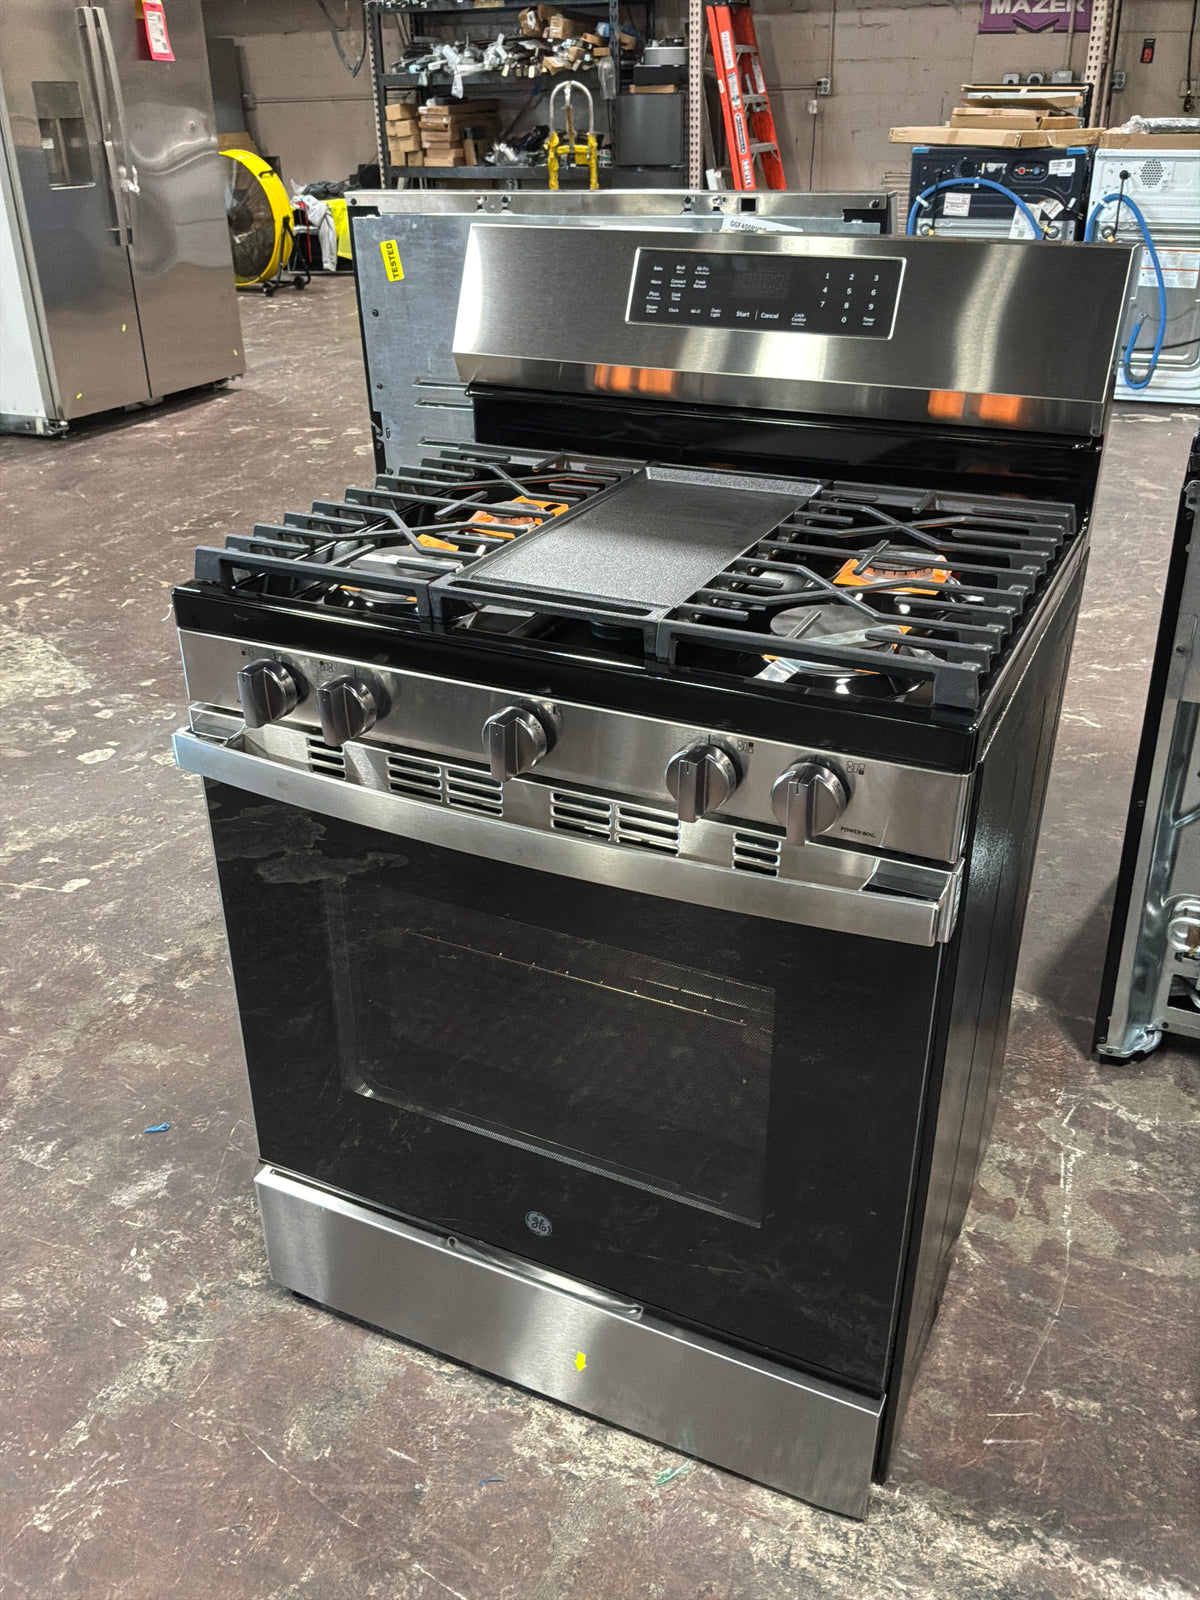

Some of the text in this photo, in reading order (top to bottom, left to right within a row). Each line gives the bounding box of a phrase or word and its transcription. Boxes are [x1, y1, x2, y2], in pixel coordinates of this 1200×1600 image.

[990, 0, 1085, 14] MAZER
[386, 243, 400, 279] TESTED
[846, 287, 852, 295] 5
[871, 288, 877, 296] 6
[820, 300, 826, 308] 7
[843, 301, 850, 309] 8
[760, 312, 779, 320] Cancel
[840, 826, 862, 834] POWER
[525, 1210, 553, 1237] GE
